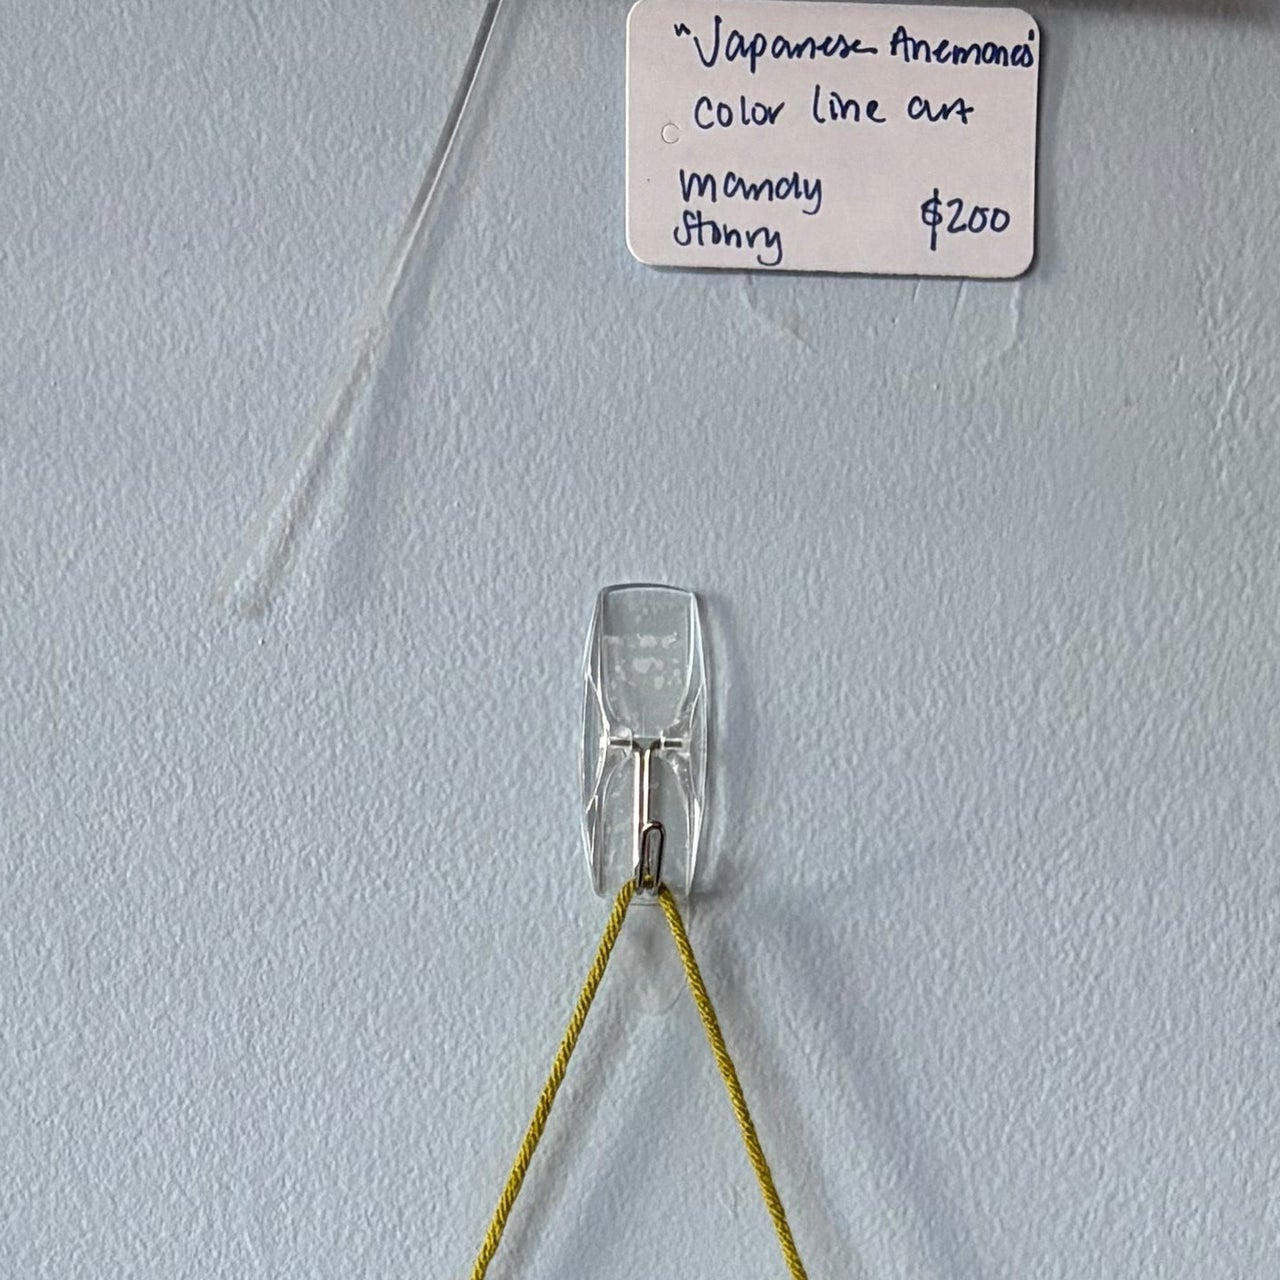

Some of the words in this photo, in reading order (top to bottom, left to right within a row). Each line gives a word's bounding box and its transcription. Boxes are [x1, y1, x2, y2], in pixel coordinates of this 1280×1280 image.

[812, 84, 887, 124] line
[907, 95, 975, 126] art
[920, 187, 1011, 251] $200
